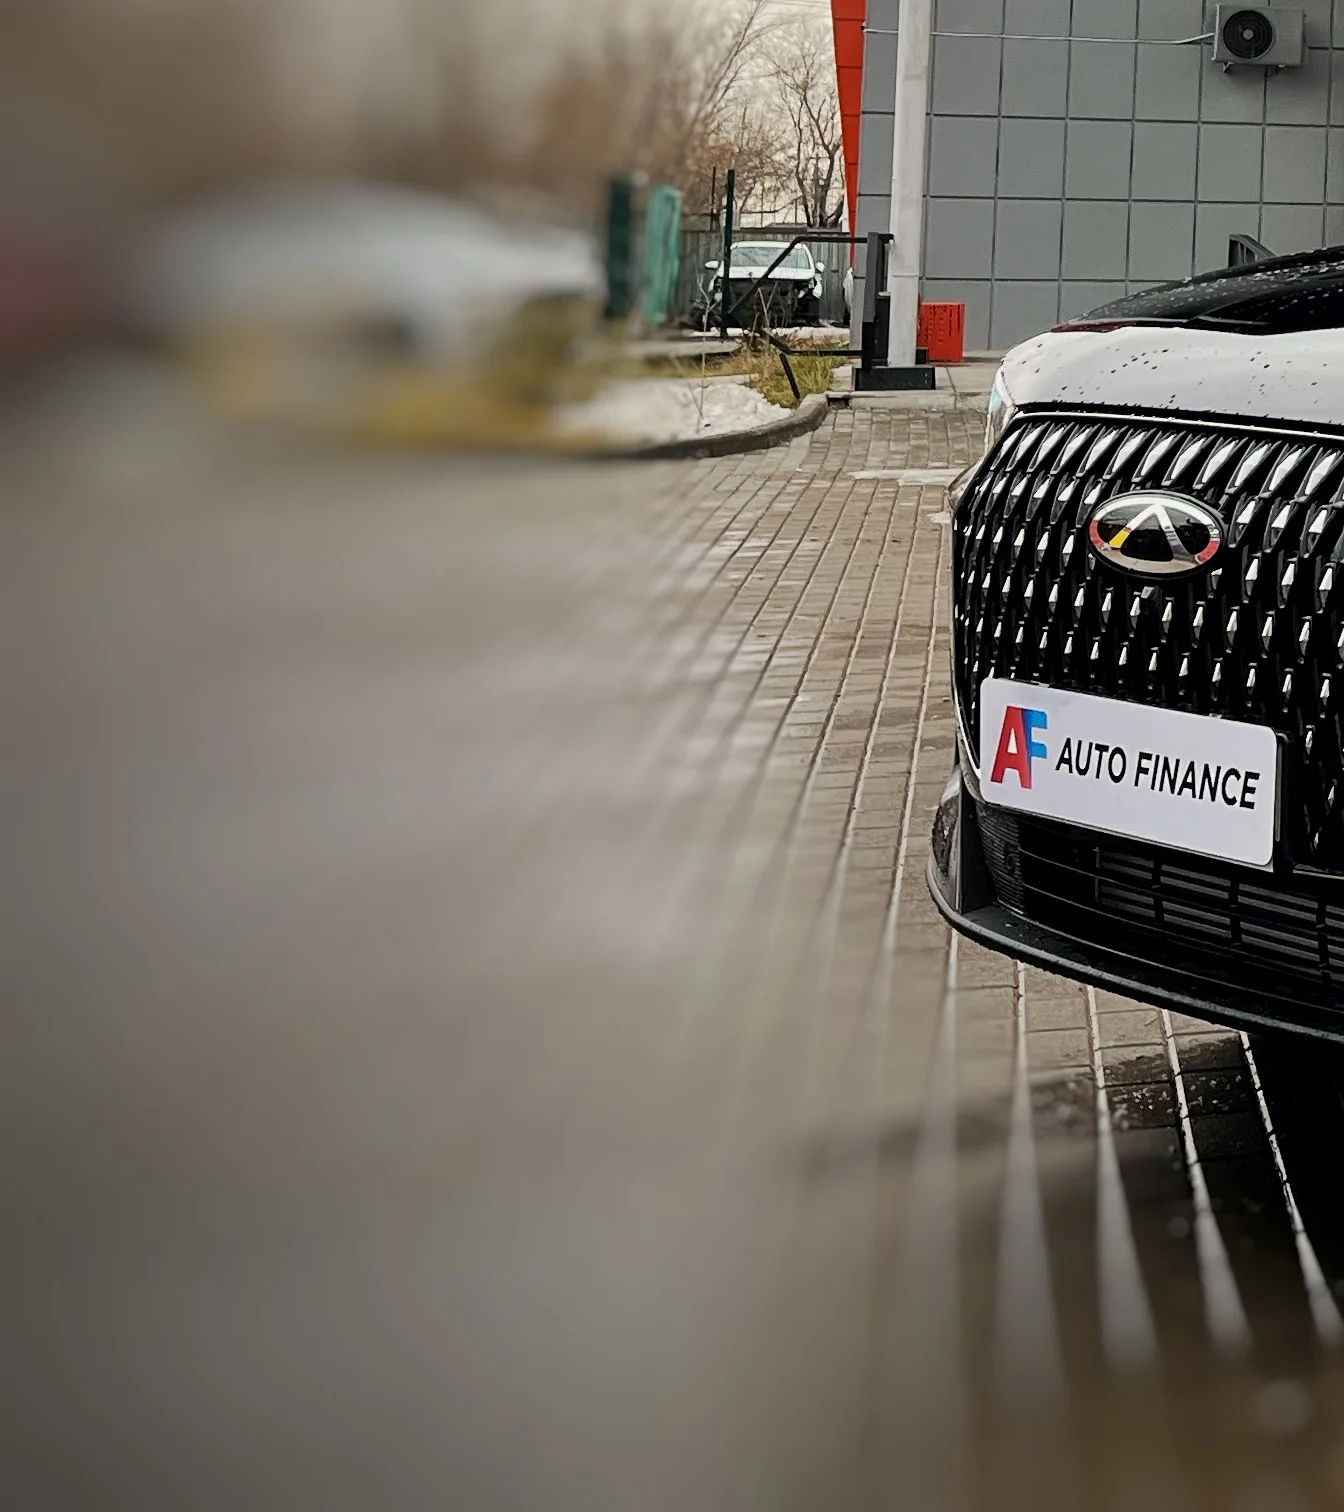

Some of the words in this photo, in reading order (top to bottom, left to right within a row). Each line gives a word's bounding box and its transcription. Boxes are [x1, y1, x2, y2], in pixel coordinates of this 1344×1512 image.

[990, 705, 1048, 790] AF
[1055, 737, 1127, 784] AUTO
[1134, 752, 1261, 810] FINANCE
